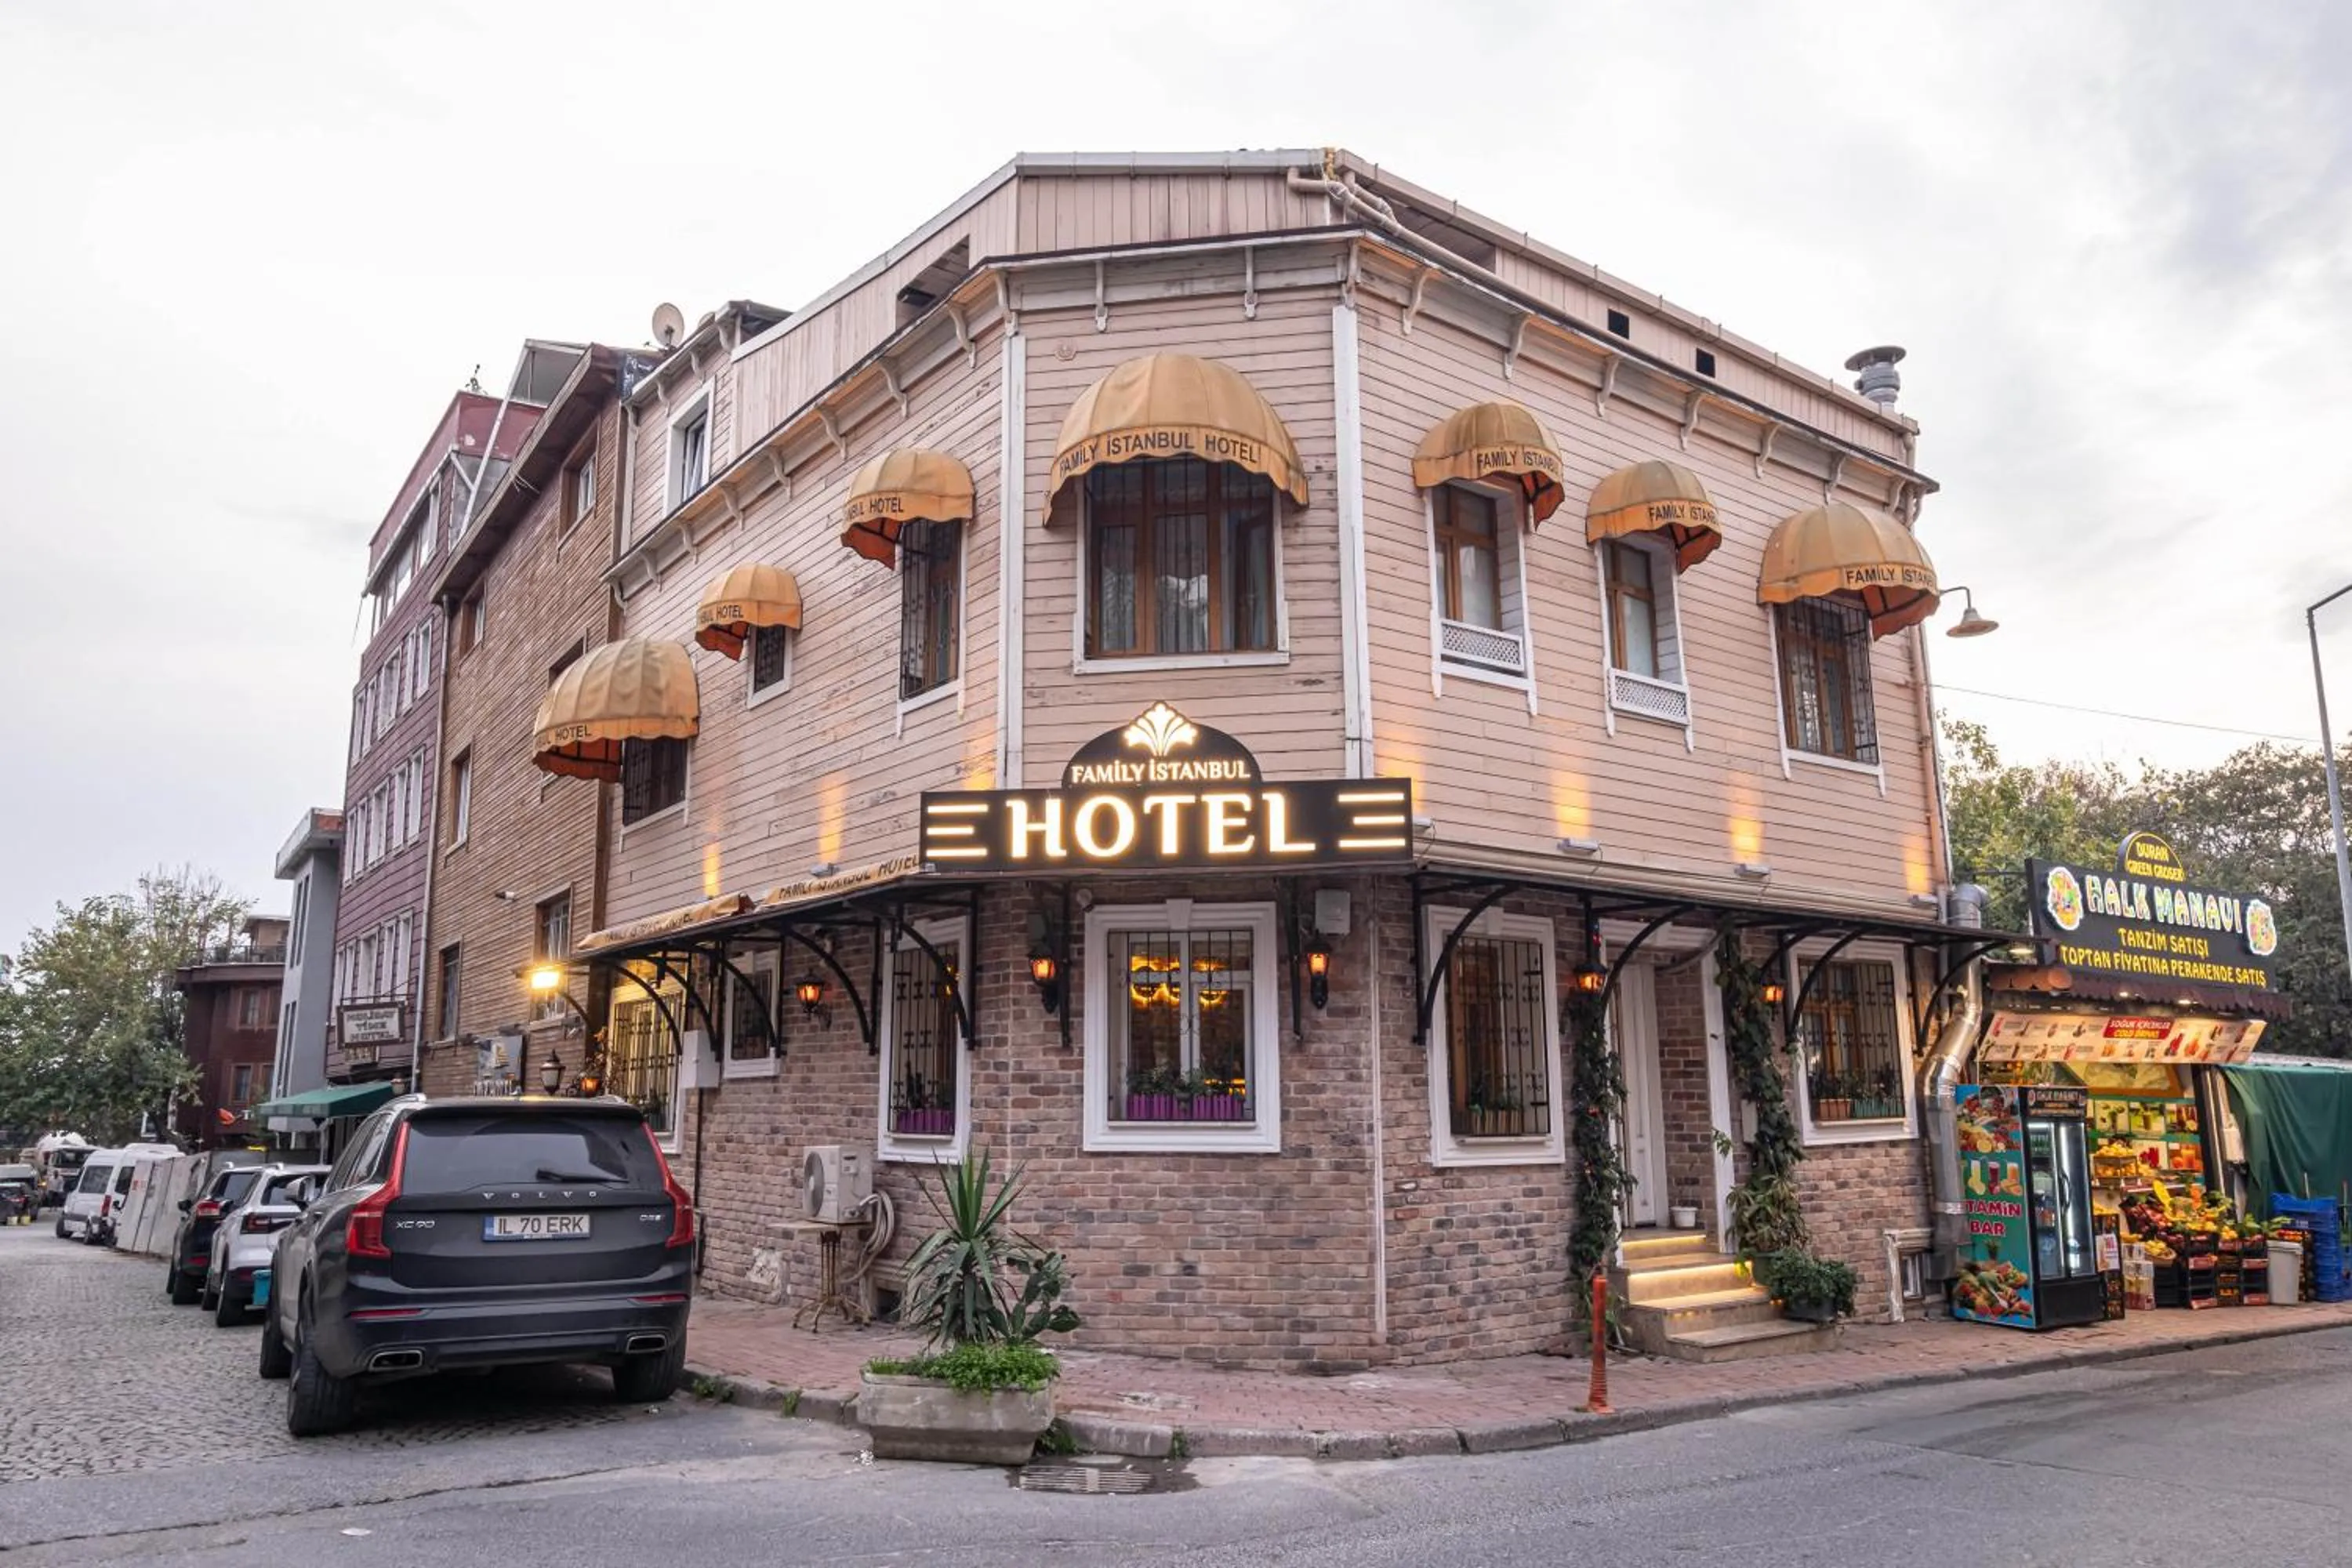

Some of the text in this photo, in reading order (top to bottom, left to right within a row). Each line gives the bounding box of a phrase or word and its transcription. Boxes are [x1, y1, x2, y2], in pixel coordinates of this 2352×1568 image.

[1106, 431, 1195, 456] İSTANBUL
[1205, 434, 1259, 464] HOTEL
[869, 496, 905, 514] HOTEL
[716, 604, 744, 620] HOTEL
[555, 724, 593, 741] HOTEL
[1072, 758, 1250, 783] FAMİLY İSTANBUL
[1007, 792, 1316, 859] HOTEL
[2085, 874, 2243, 933] HALK MANAVI
[2118, 927, 2209, 960] TANZİM SATIŞI
[2060, 946, 2267, 989] TOPTAN FİYATINA PERAKENDE SATIŞ
[482, 1191, 597, 1200] VOLVO
[1966, 1200, 2022, 1216] TAMİN
[499, 1216, 585, 1235] IL 70 ERK
[1969, 1220, 2005, 1236] BAR
